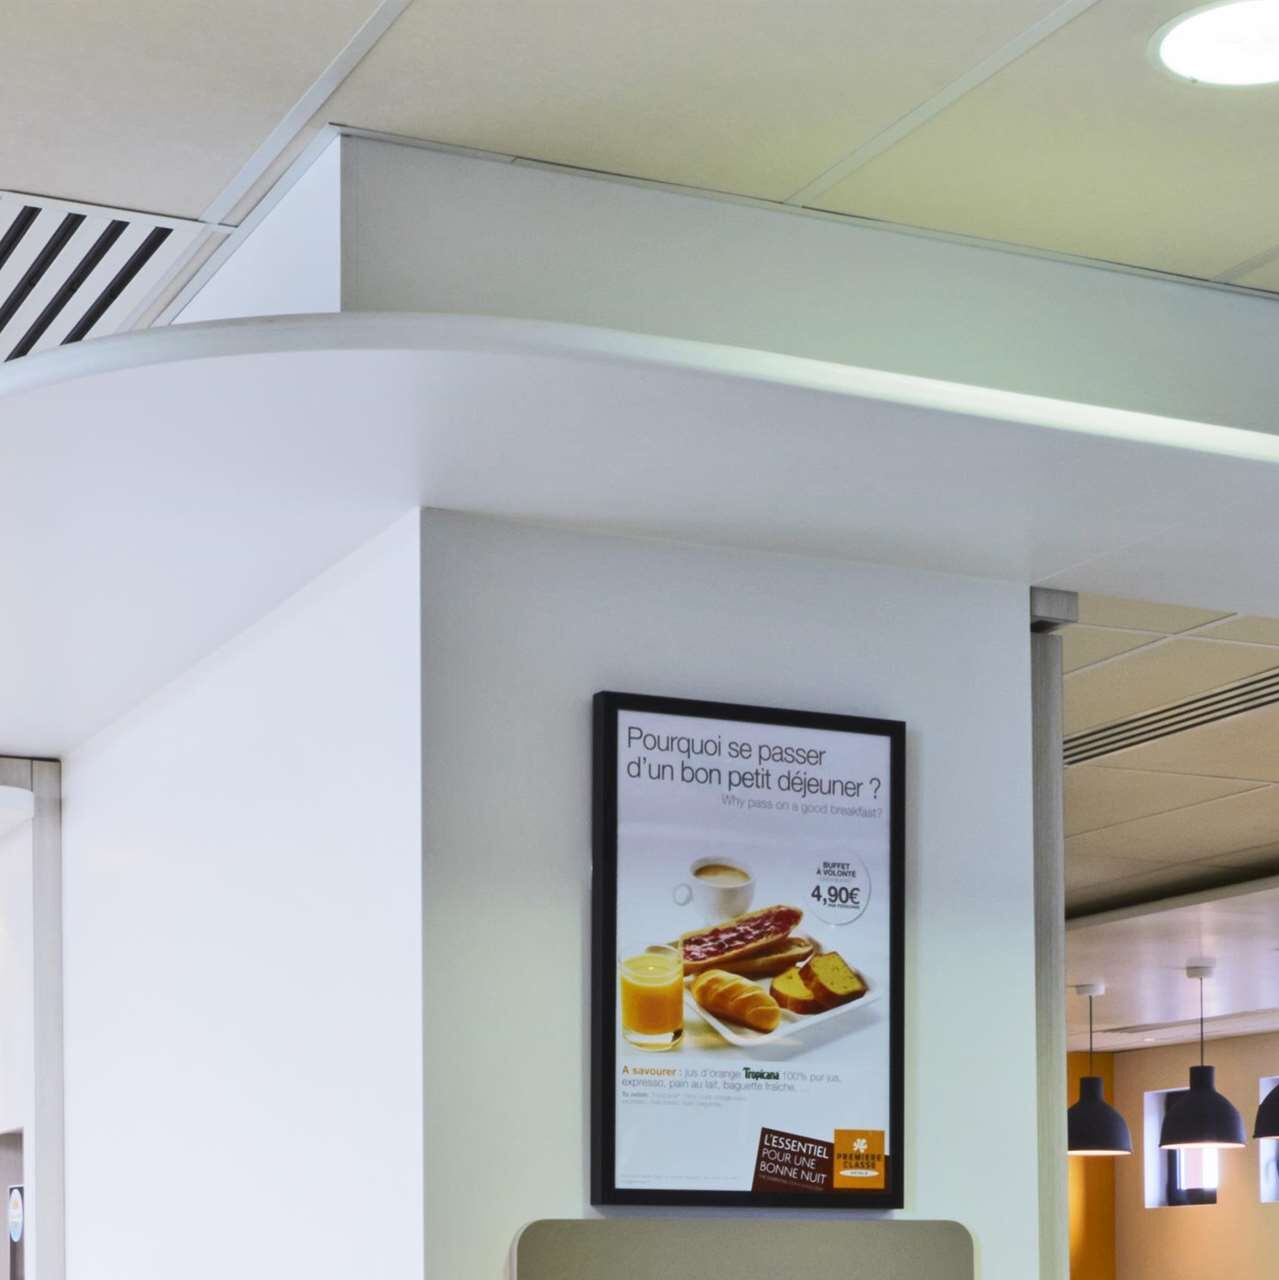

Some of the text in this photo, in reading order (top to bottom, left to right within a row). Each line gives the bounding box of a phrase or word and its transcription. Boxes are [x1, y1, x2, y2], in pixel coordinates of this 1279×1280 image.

[627, 726, 826, 766] Pourquoi se passer
[627, 757, 673, 781] d'un
[681, 761, 721, 785] bon
[728, 768, 771, 791] petit
[777, 771, 863, 798] déjeuner
[721, 795, 883, 819] Why pass on a good breakfast?
[811, 885, 860, 906] 4,90€
[633, 1067, 677, 1077] savourer
[743, 1067, 780, 1081] Tropicana
[723, 1081, 762, 1092] baguette
[764, 1133, 829, 1159] L'ESSENTIEL
[761, 1147, 816, 1169] POUR UNE
[760, 1161, 799, 1179] BONNE
[801, 1170, 827, 1184] NUIT
